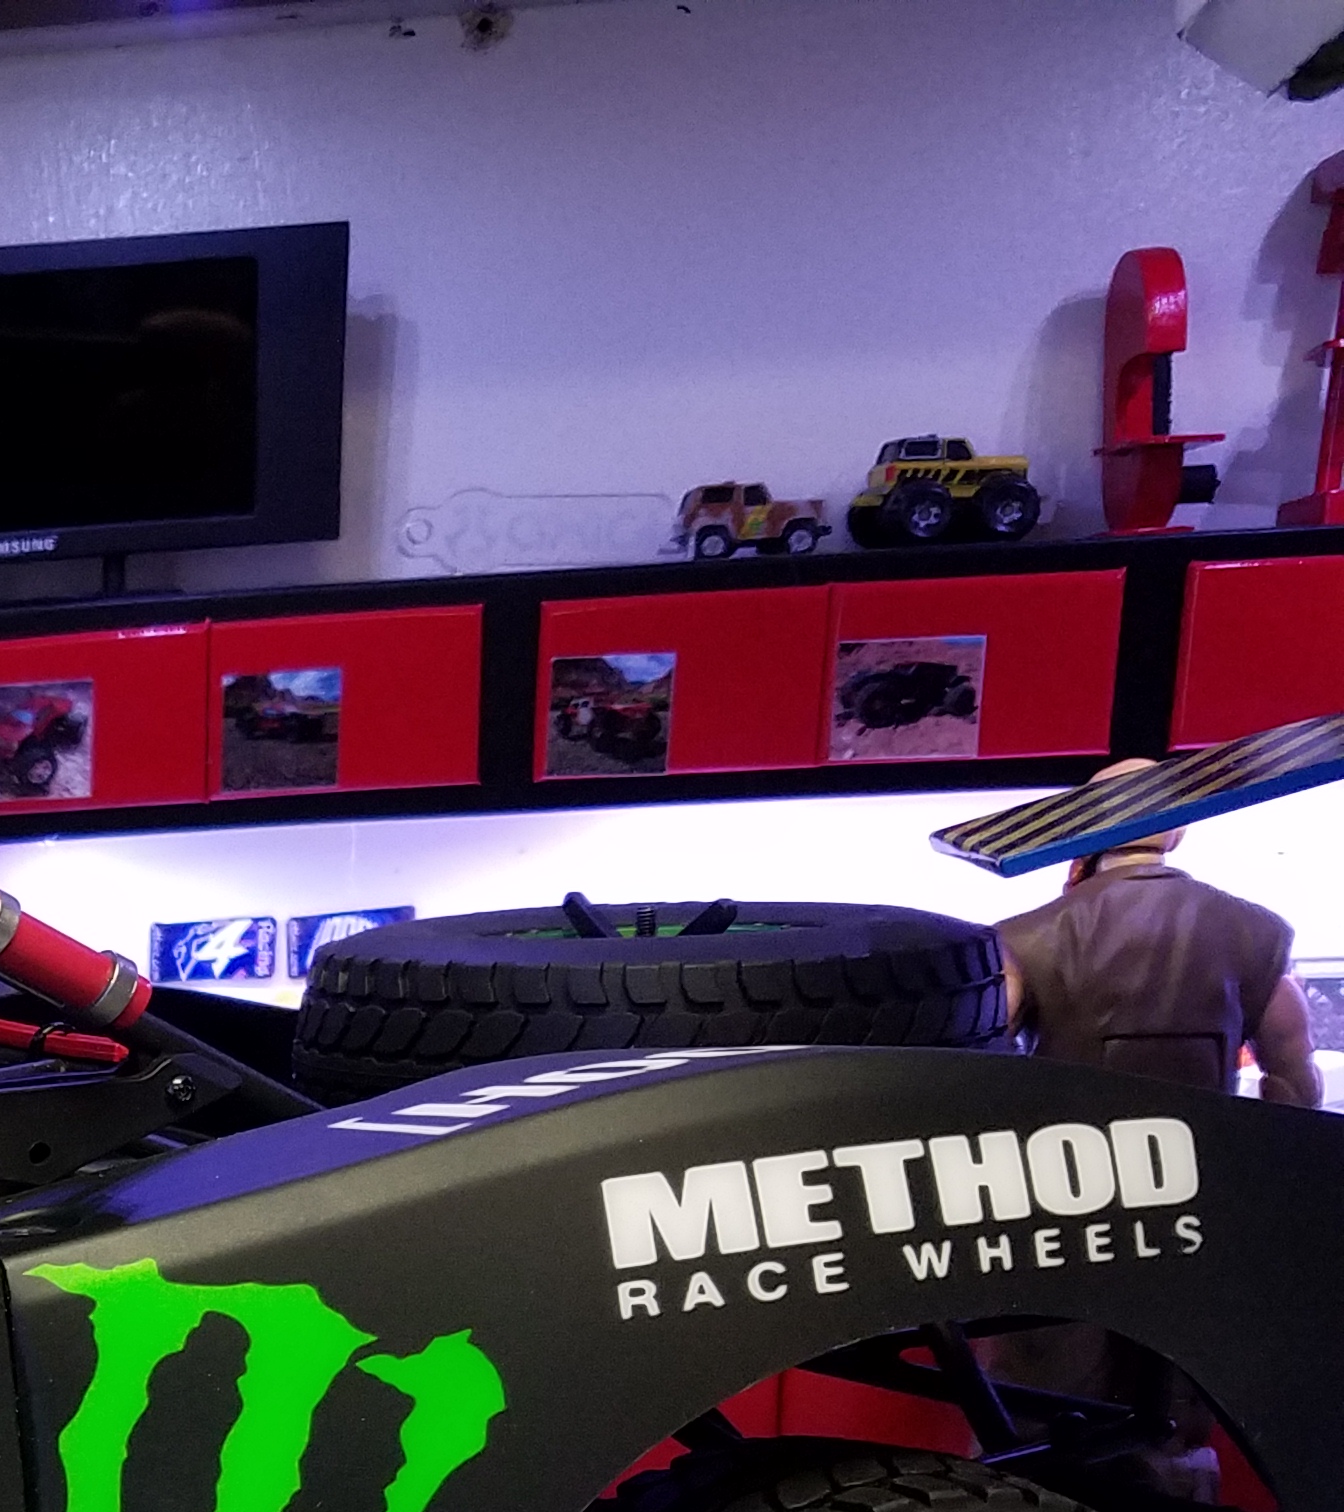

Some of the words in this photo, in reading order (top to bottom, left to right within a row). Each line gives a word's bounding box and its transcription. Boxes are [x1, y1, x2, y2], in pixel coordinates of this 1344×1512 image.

[599, 1117, 1201, 1270] METHOD
[616, 1251, 852, 1320] RACE
[901, 1215, 1205, 1282] WHEELS
